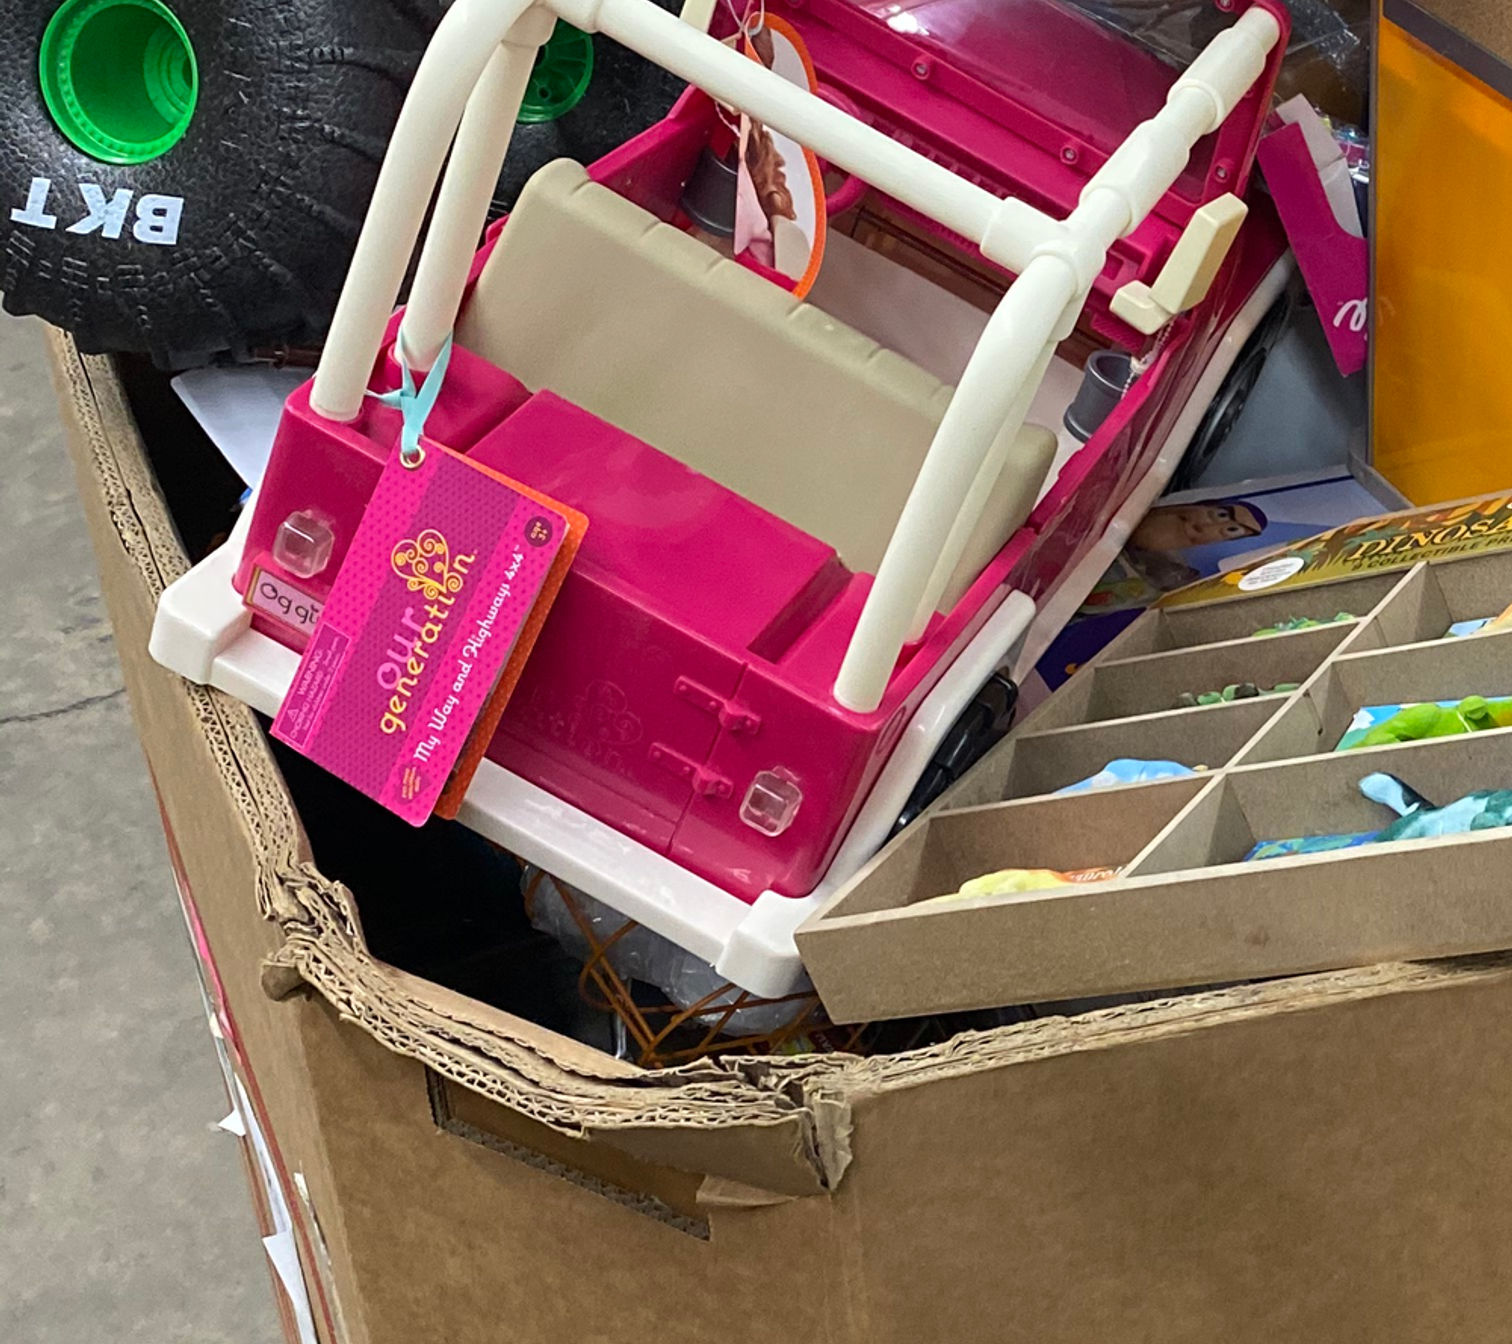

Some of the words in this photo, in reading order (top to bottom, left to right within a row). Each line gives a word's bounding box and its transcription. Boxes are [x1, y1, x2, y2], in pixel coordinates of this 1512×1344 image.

[10, 176, 185, 246] BKT
[1365, 539, 1483, 568] COLLECTIBLE
[462, 582, 511, 659] Highways
[377, 606, 425, 690] our
[452, 659, 474, 693] and
[428, 693, 461, 732] Way
[413, 733, 442, 763] My
